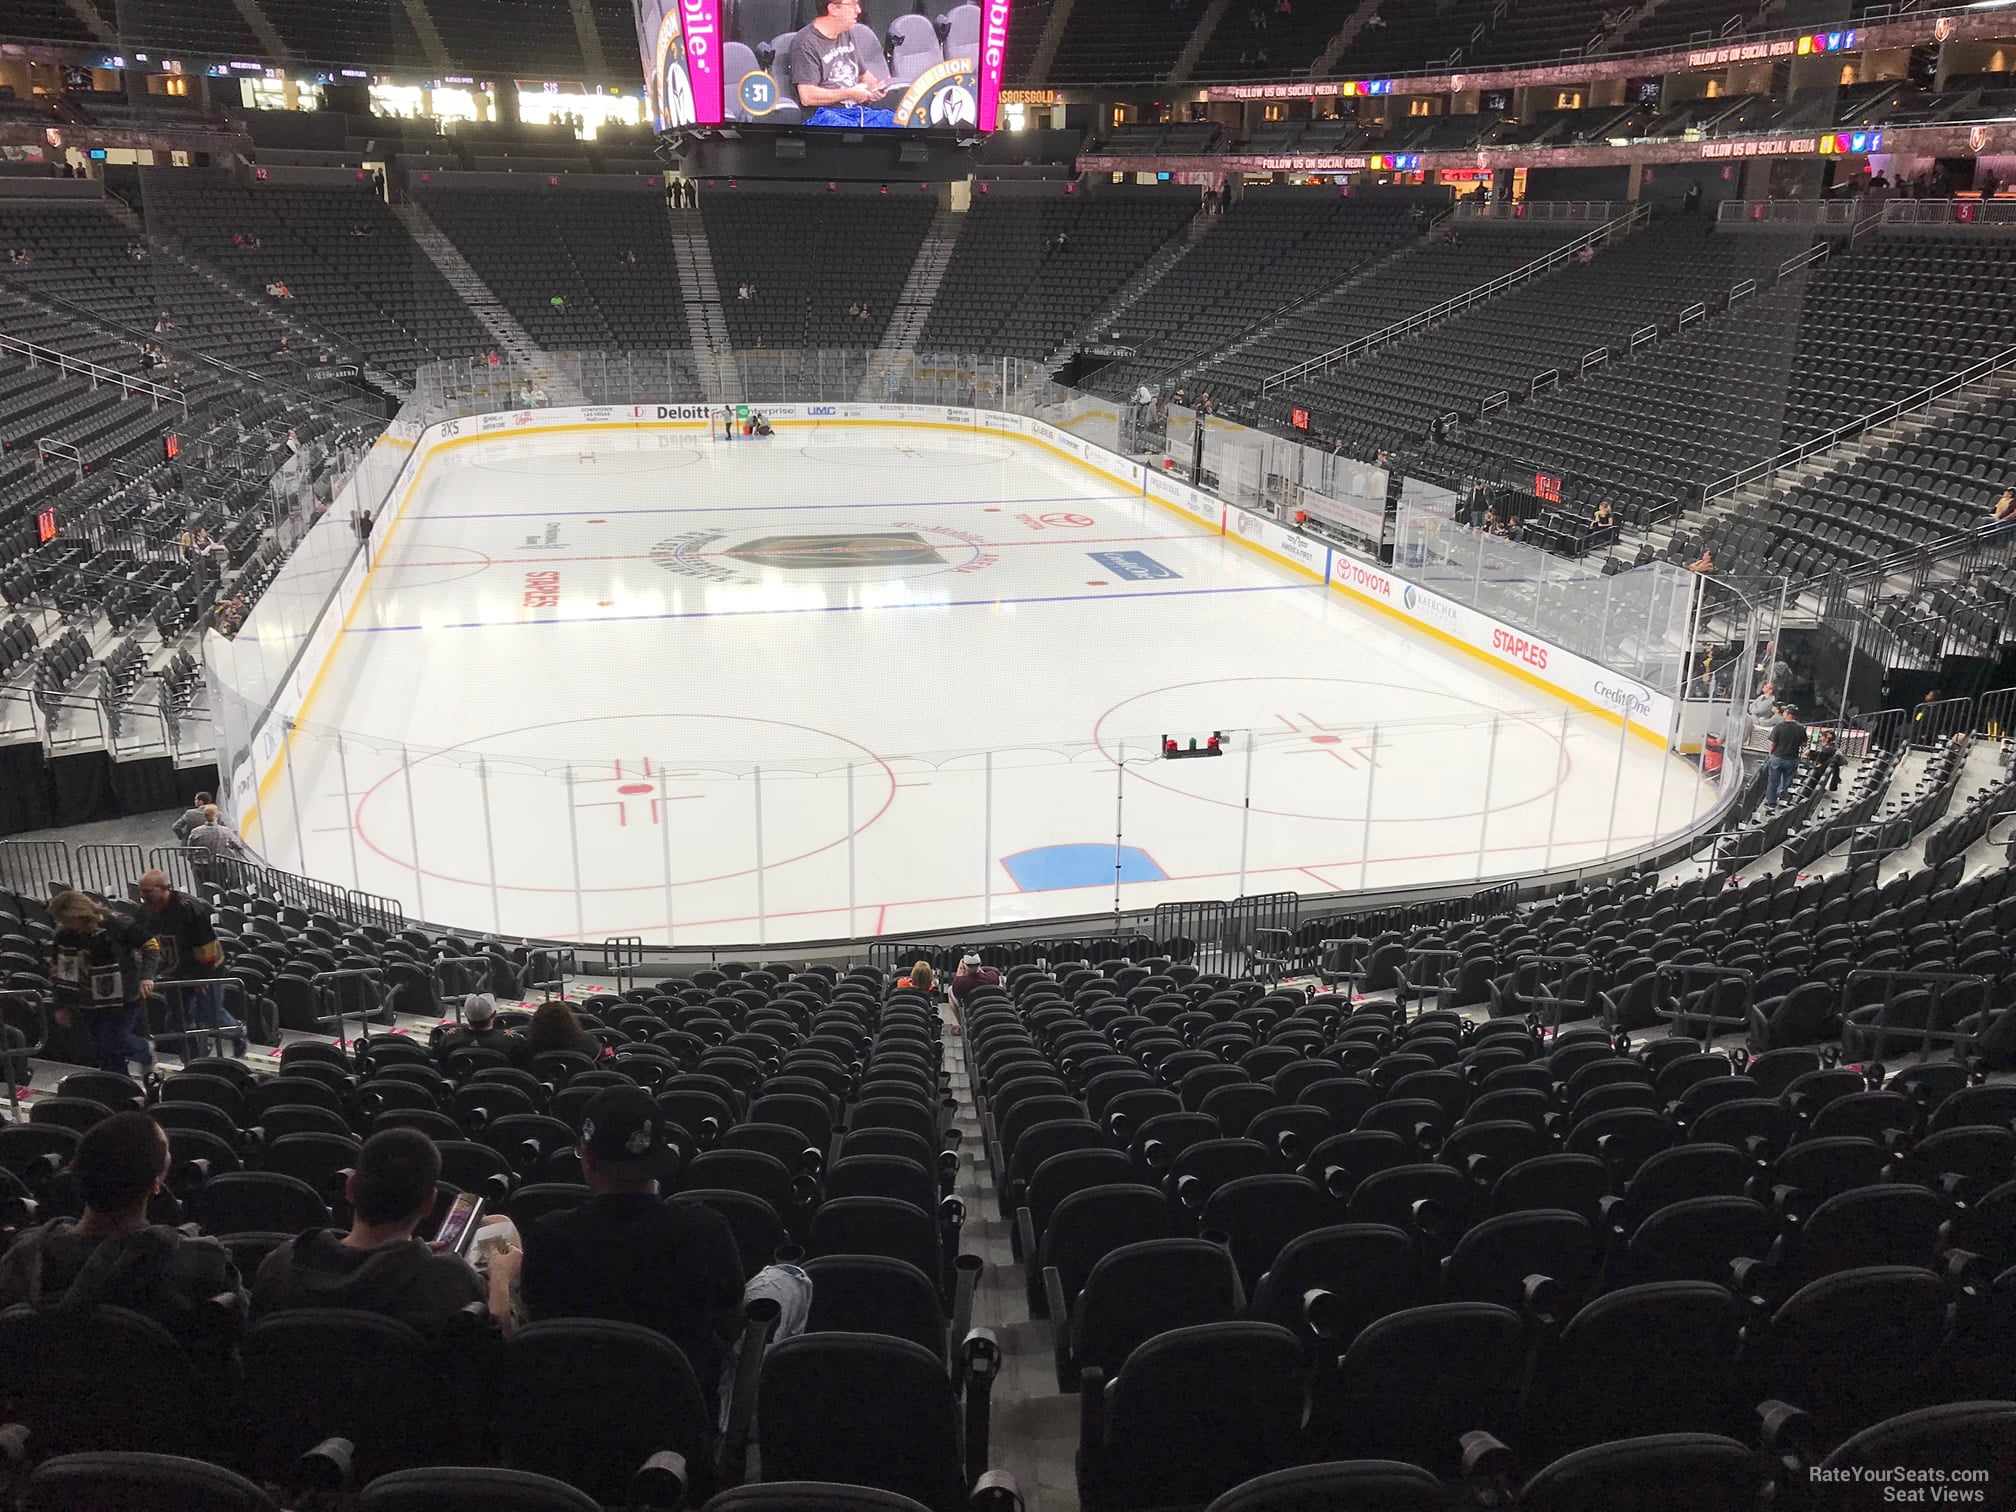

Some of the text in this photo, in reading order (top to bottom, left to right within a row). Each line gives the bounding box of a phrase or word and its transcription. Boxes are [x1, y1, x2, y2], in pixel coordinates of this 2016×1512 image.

[1689, 52, 1717, 67] FOLLOW
[1717, 50, 1728, 63] US
[1729, 49, 1740, 62] ON
[1741, 45, 1768, 60] SOCIAL
[1769, 41, 1794, 56] MEDIA
[1235, 87, 1263, 98] FOLLOW
[1264, 87, 1275, 97] US
[1276, 86, 1286, 97] ON
[1287, 85, 1313, 96] SOCIAL
[1314, 84, 1338, 96] MEDIA
[1702, 144, 1731, 158] FOLLOW
[1732, 143, 1744, 156] US
[1745, 143, 1757, 155] ON
[1758, 140, 1786, 155] SOCIAL
[1788, 139, 1815, 154] MEDIA
[1262, 158, 1291, 169] FOLLOW
[1293, 158, 1303, 169] US
[1305, 158, 1315, 169] ON
[1317, 158, 1343, 169] SOCIAL
[1345, 157, 1366, 168] MEDIA
[807, 406, 836, 415] UMC
[441, 420, 460, 438] axs
[1352, 566, 1391, 598] TOYOTA
[1493, 628, 1548, 670] STAPLES
